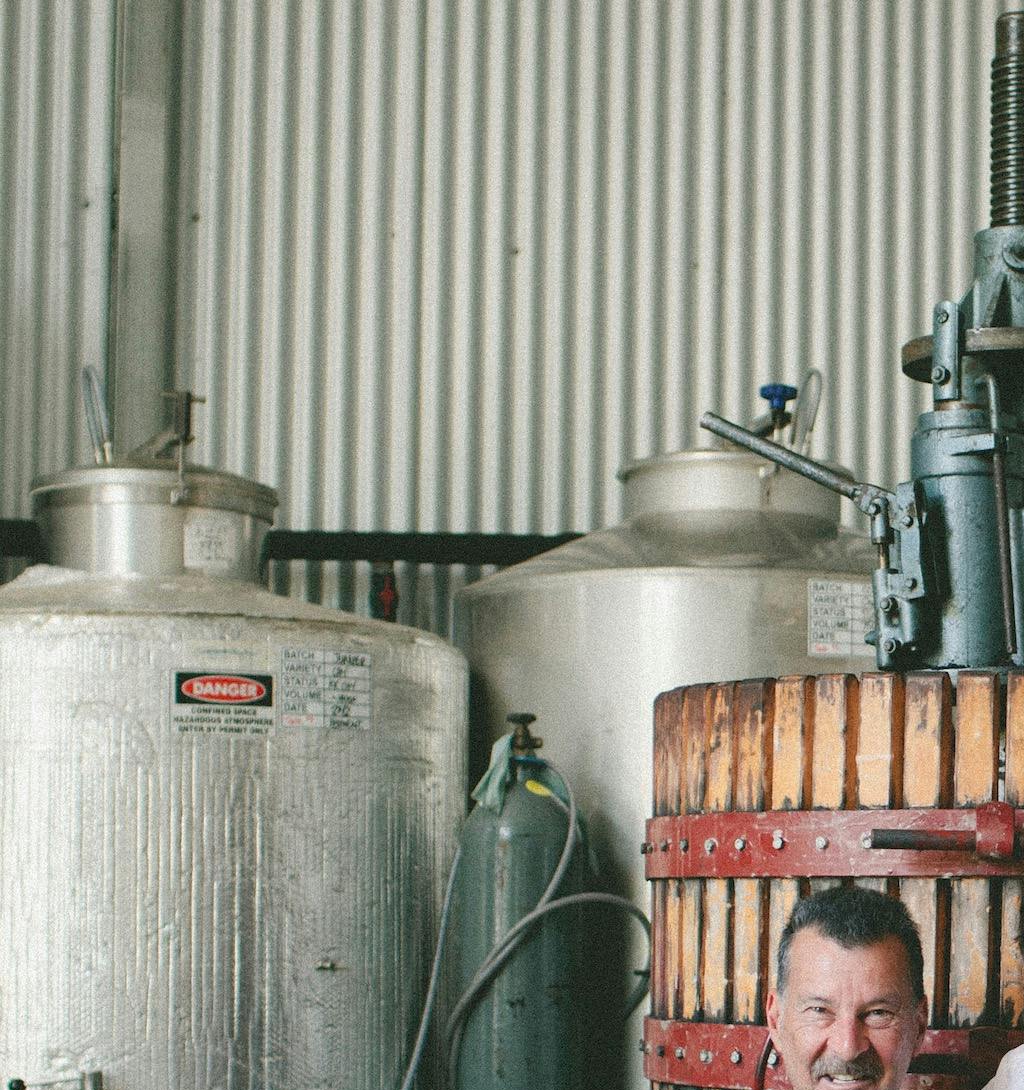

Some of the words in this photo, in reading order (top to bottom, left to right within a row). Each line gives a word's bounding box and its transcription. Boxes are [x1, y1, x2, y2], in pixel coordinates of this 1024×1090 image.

[812, 583, 842, 591] BATCH
[813, 608, 846, 617] STATUS
[284, 648, 315, 659] BATCH
[284, 662, 322, 673] VARIETY
[283, 675, 319, 687] STATUS
[192, 681, 257, 697] DANGER
[284, 689, 321, 700] VOLUME
[191, 706, 232, 715] CONFINED
[234, 708, 257, 716] SPACE
[284, 702, 307, 713] DATE
[174, 716, 222, 724] HAZARDOUS
[224, 717, 274, 726] ATMOSPHERE
[178, 725, 205, 733] ENTER
[219, 726, 247, 734] PERMIT
[250, 727, 269, 735] ONLY
